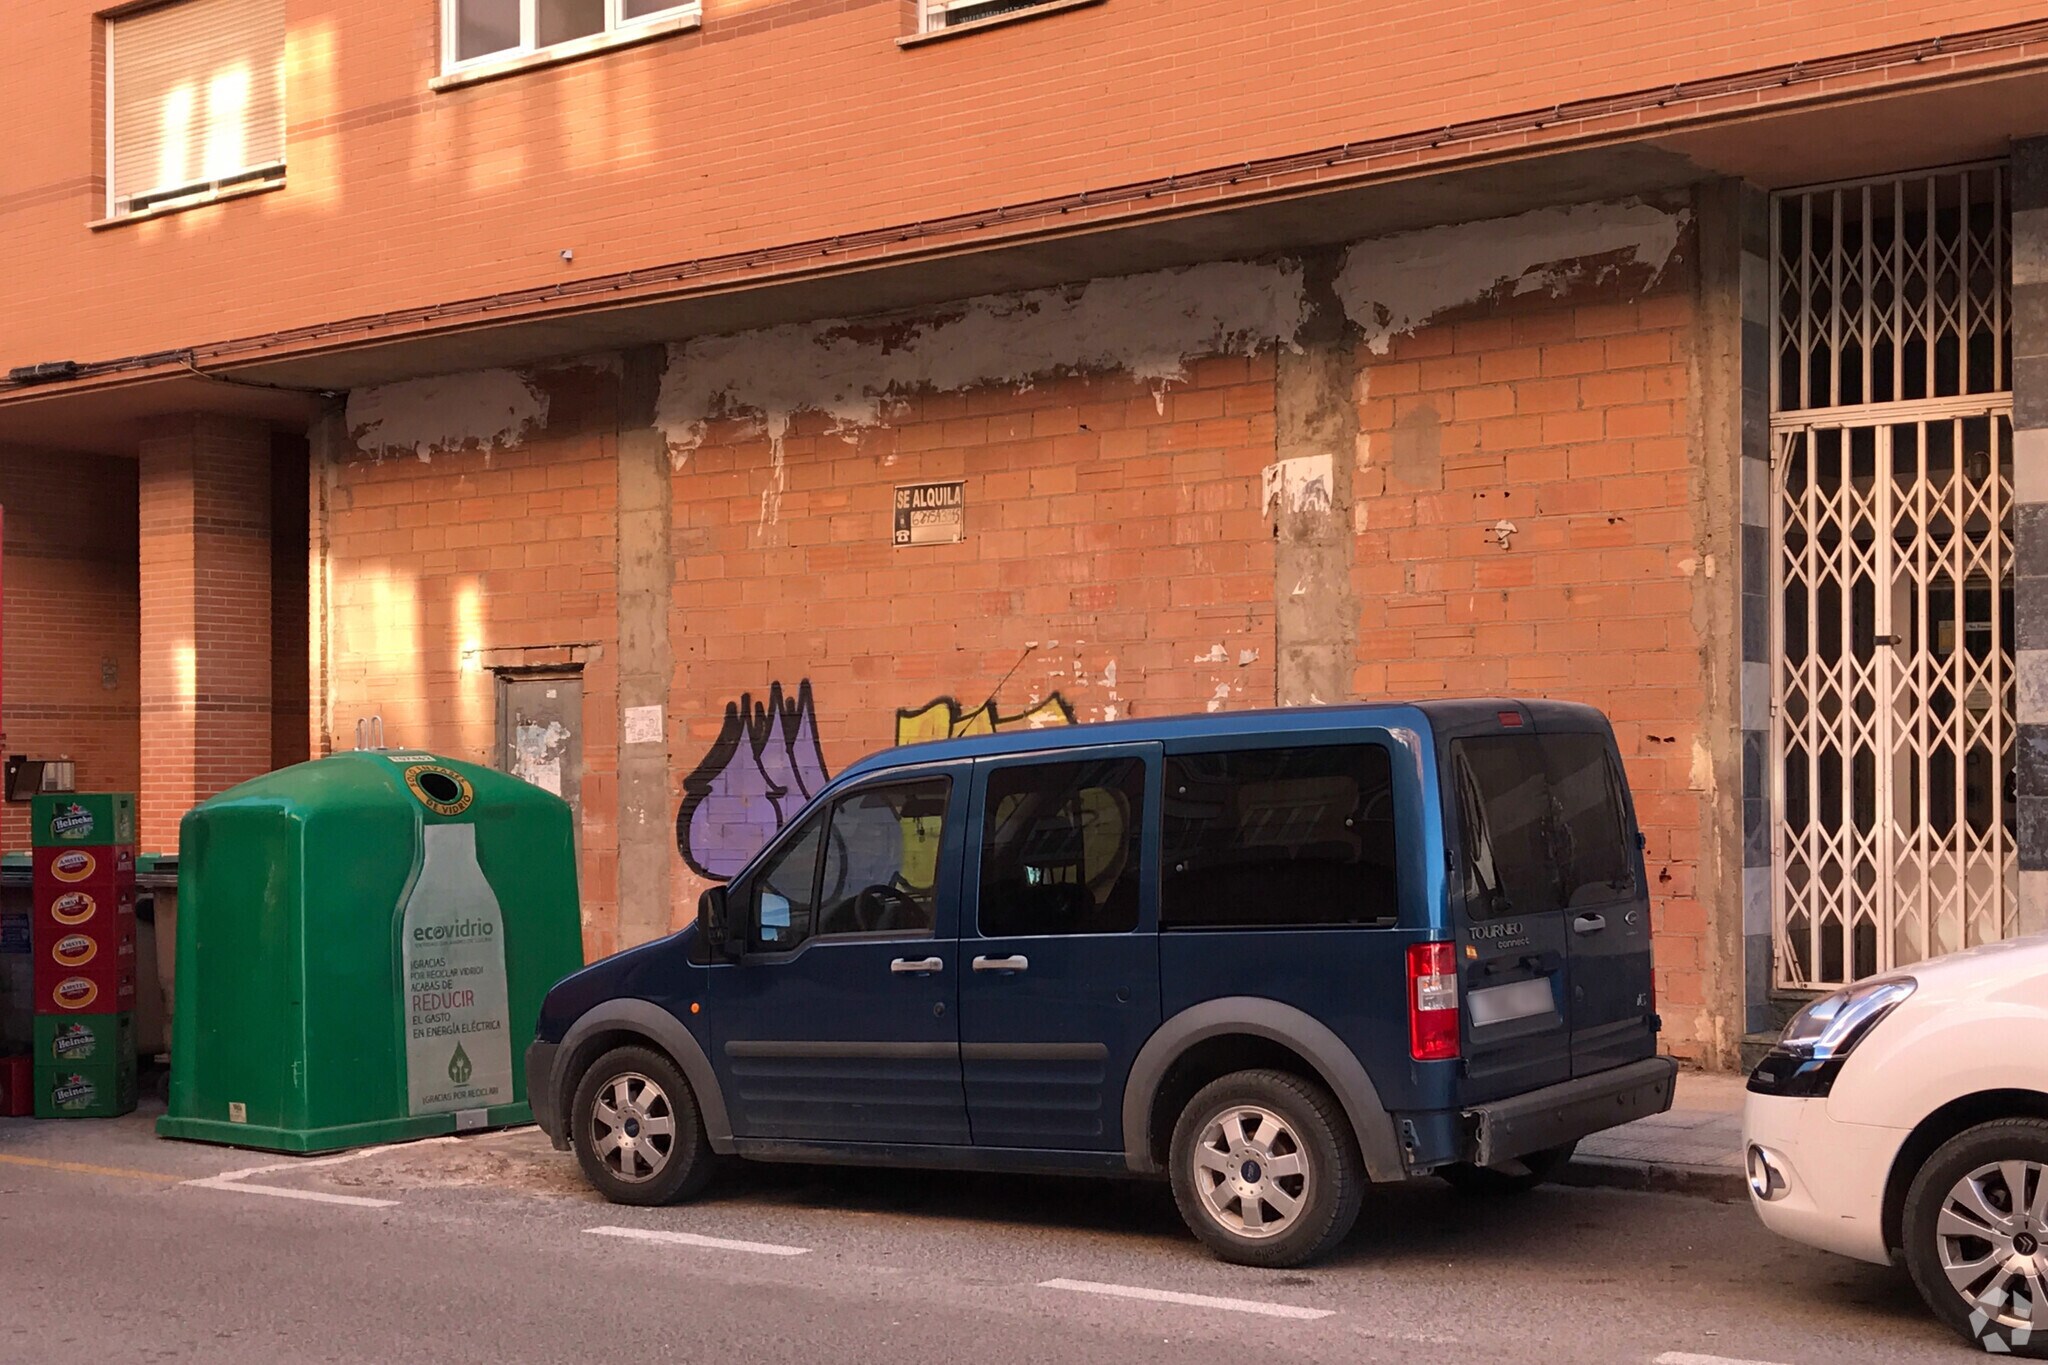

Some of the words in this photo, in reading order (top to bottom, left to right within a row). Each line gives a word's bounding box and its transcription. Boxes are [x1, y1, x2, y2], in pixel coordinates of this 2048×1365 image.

[897, 490, 910, 509] SE
[912, 486, 961, 508] ALQUILA
[426, 799, 438, 811] DE
[442, 795, 471, 814] VIDRIO
[413, 918, 493, 940] ecovidrio
[1469, 922, 1524, 940] TOURNEO
[1497, 937, 1530, 949] connect
[411, 972, 424, 981] POR
[427, 968, 459, 979] RECICLAR
[411, 981, 440, 992] ACABAS
[442, 979, 453, 990] DE
[412, 989, 475, 1012] REDUCIR
[412, 1015, 422, 1026] EL
[425, 1012, 451, 1024] GASTO
[413, 1029, 424, 1039] EN
[426, 1022, 460, 1037] ENERGÍA
[461, 1020, 501, 1034] ELÉCTRICA
[453, 1090, 467, 1100] POR
